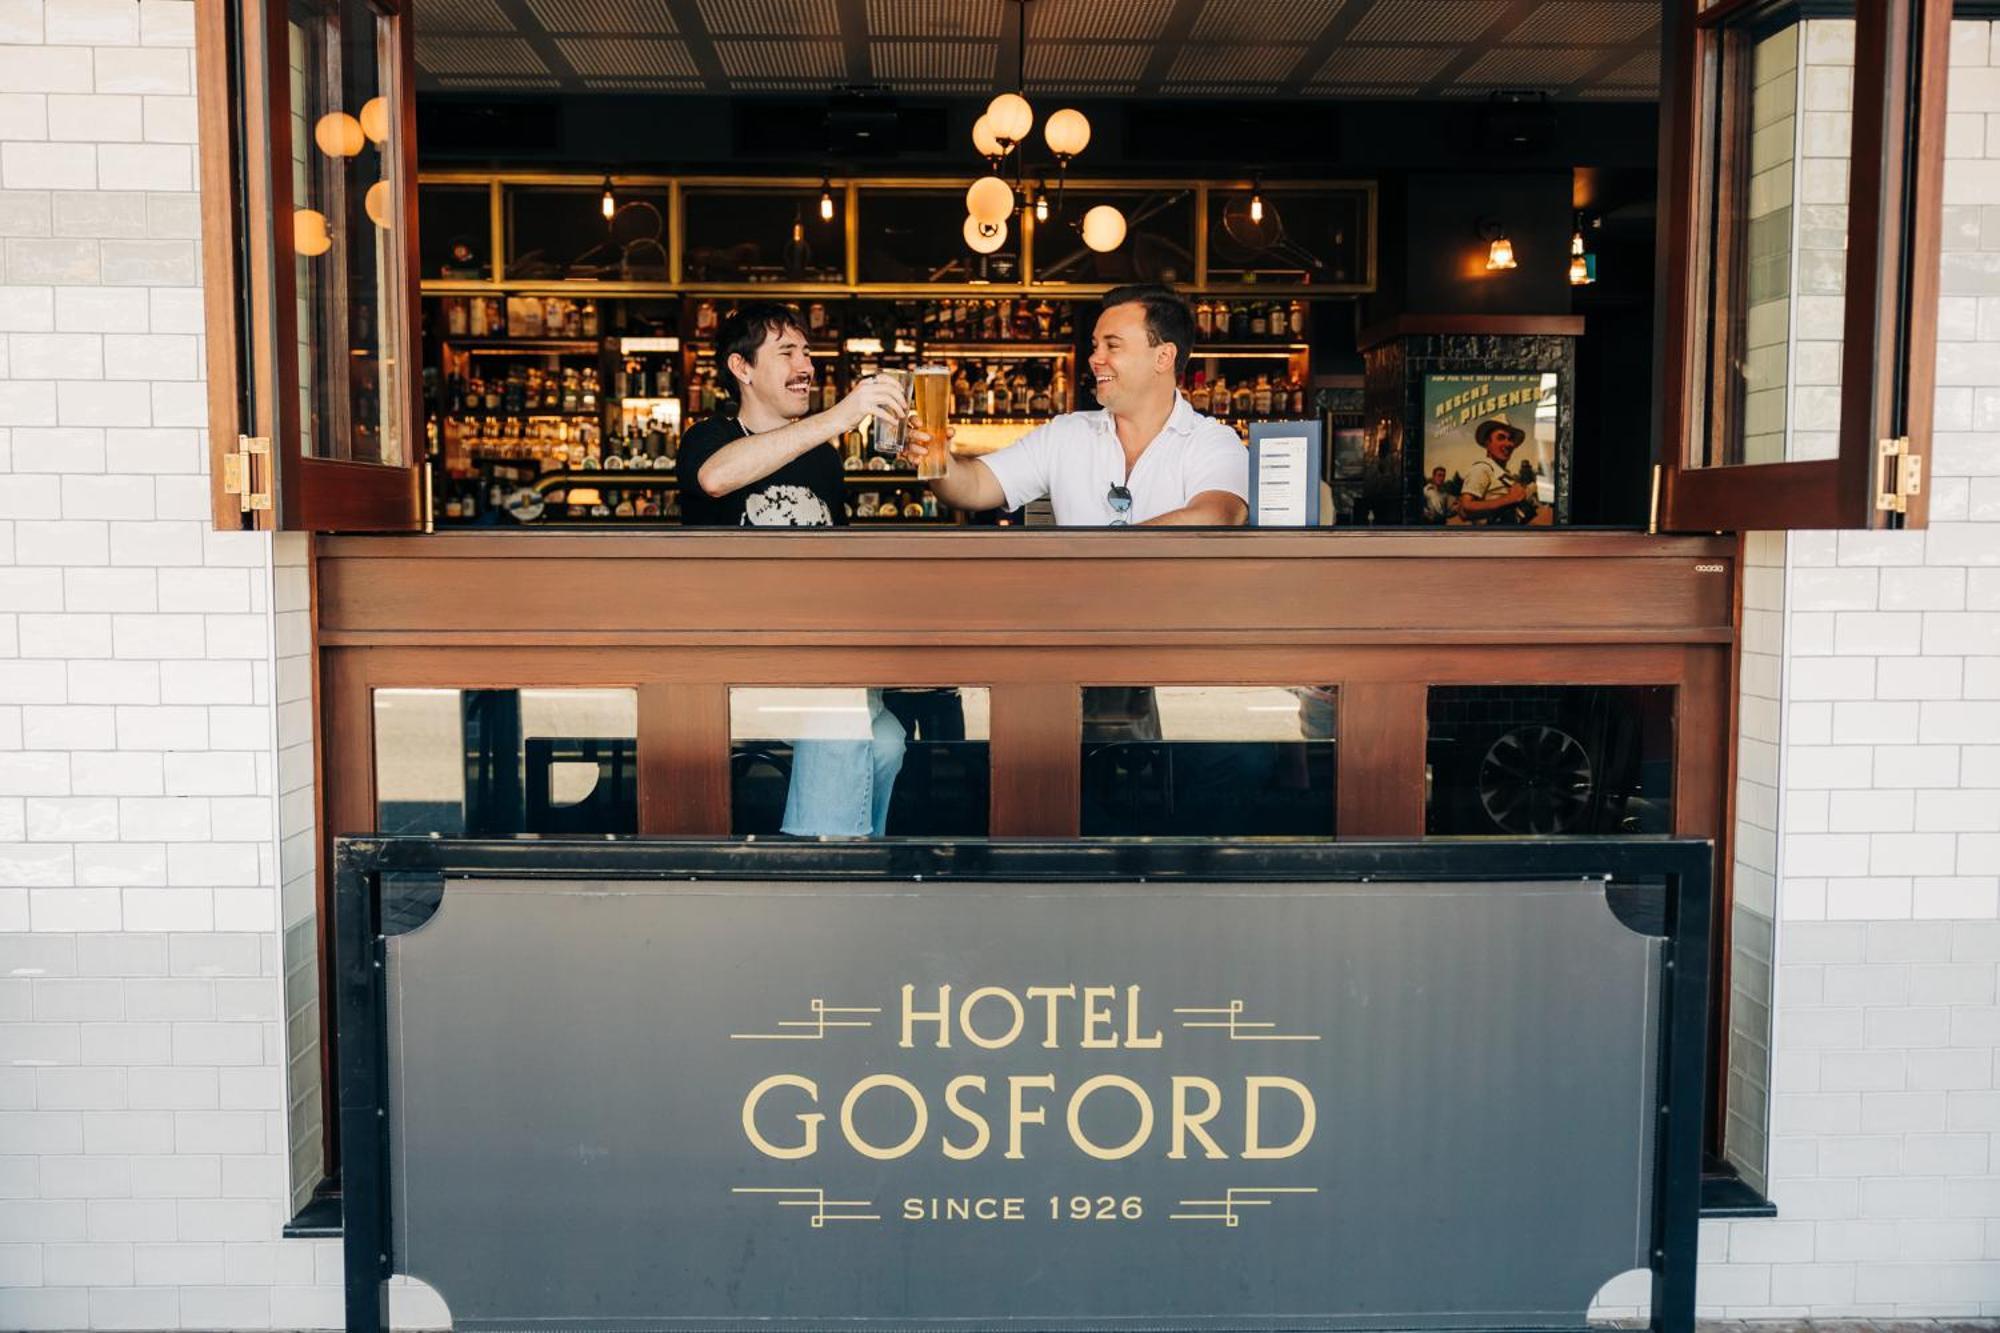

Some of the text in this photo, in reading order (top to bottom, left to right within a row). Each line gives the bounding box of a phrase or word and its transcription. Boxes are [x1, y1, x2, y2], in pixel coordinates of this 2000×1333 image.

[898, 982, 1164, 1050] HOTEL
[741, 1073, 1317, 1161] GOSFORD
[903, 1195, 1144, 1221] SINCE 1926
